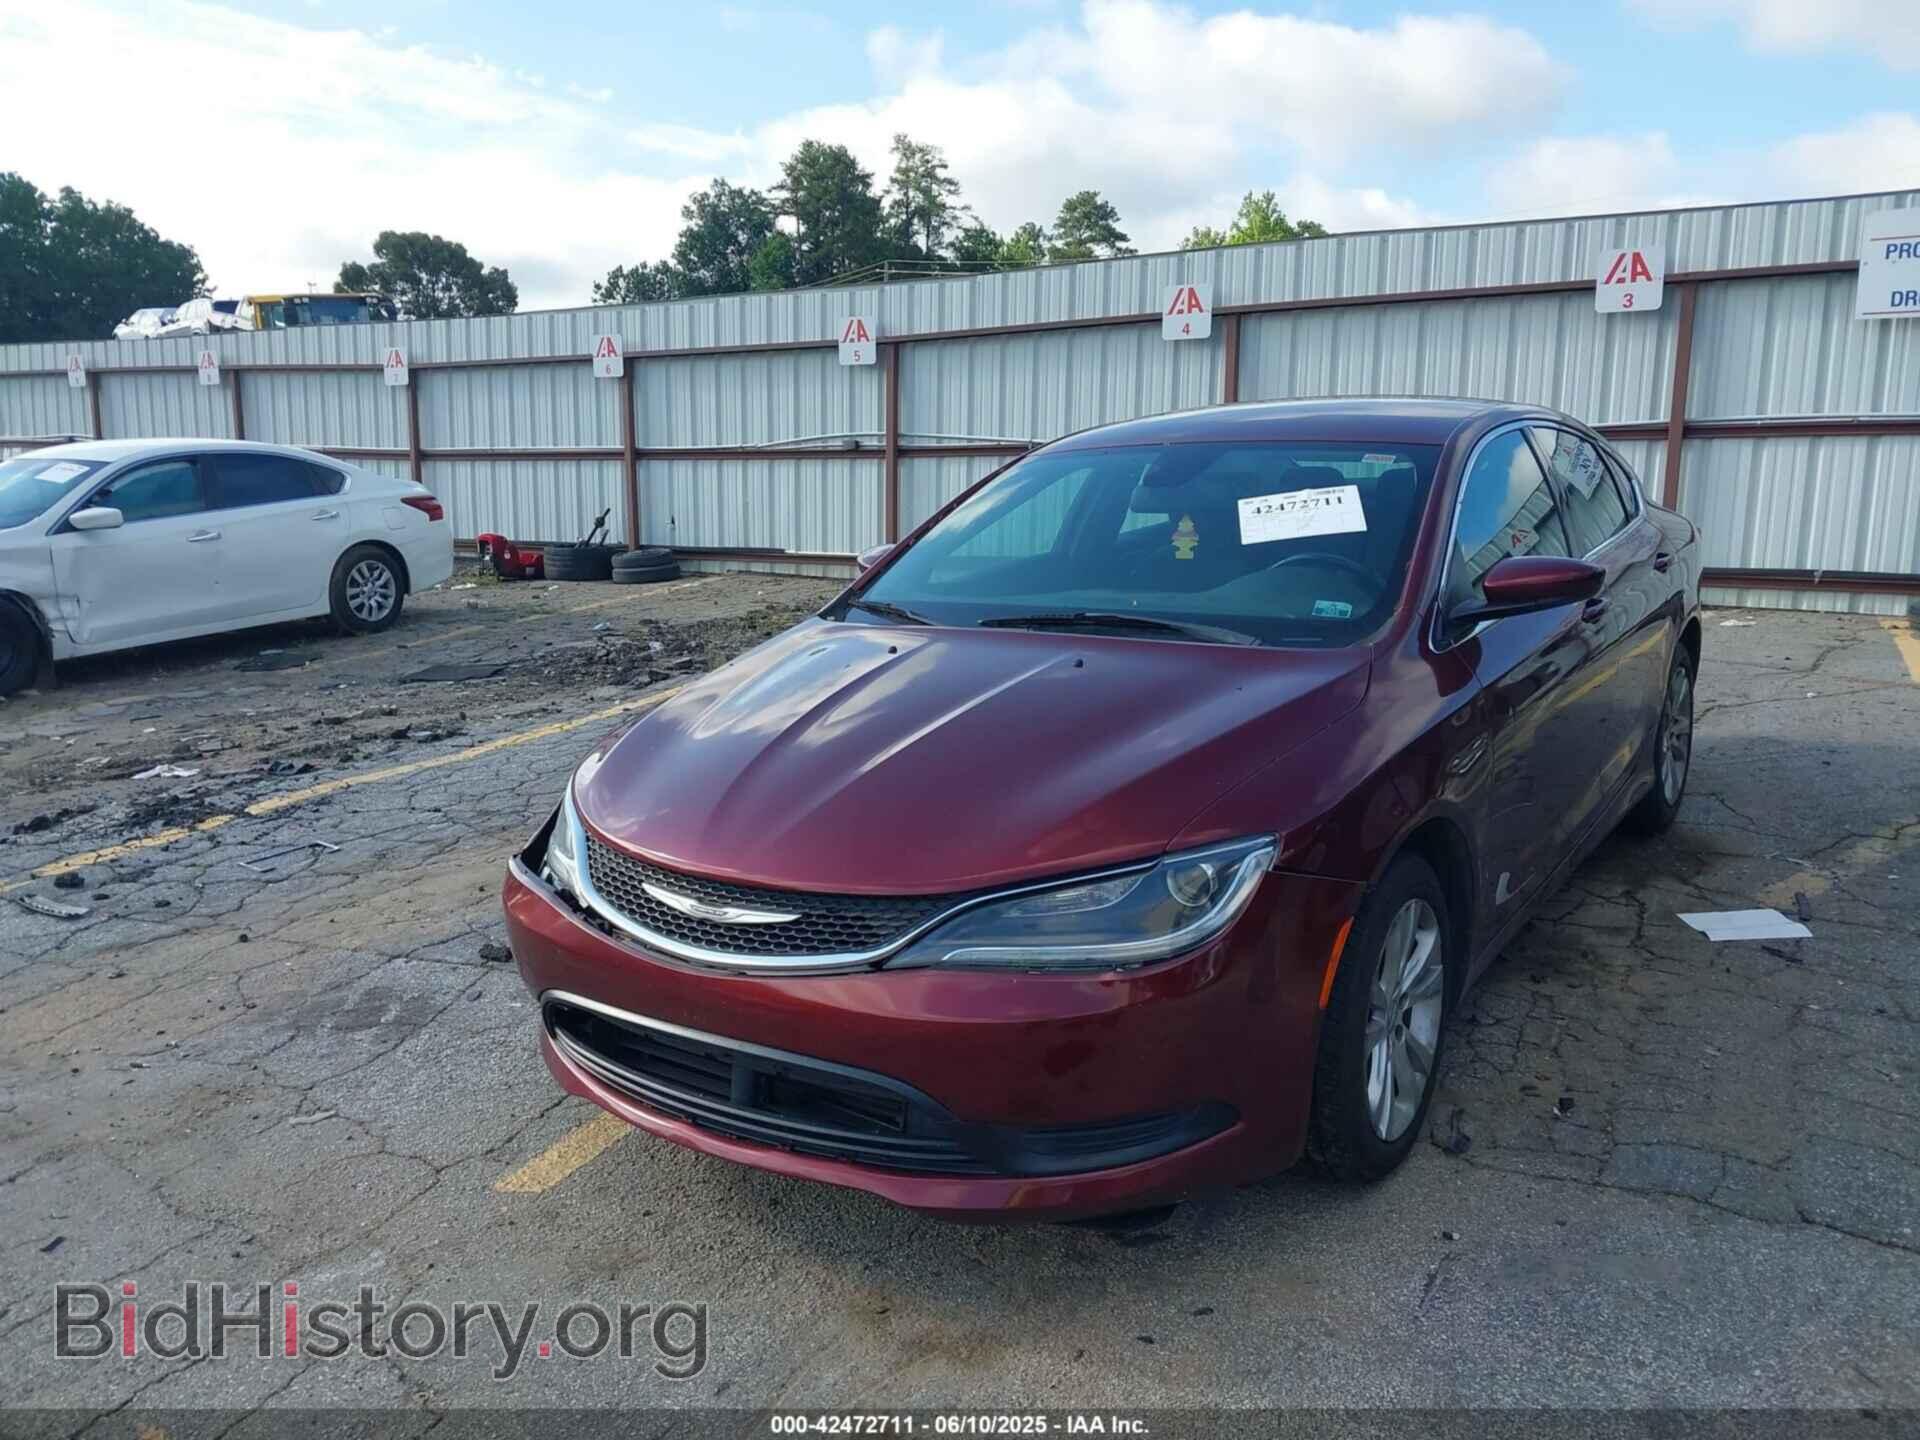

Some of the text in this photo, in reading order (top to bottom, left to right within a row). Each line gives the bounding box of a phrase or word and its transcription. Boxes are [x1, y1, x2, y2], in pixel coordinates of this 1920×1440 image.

[1622, 293, 1634, 309] 3
[1890, 290, 1920, 308] DR
[1182, 323, 1192, 336] 4
[853, 350, 862, 363] 5
[605, 364, 612, 375] 6
[1251, 496, 1343, 515] 42472711
